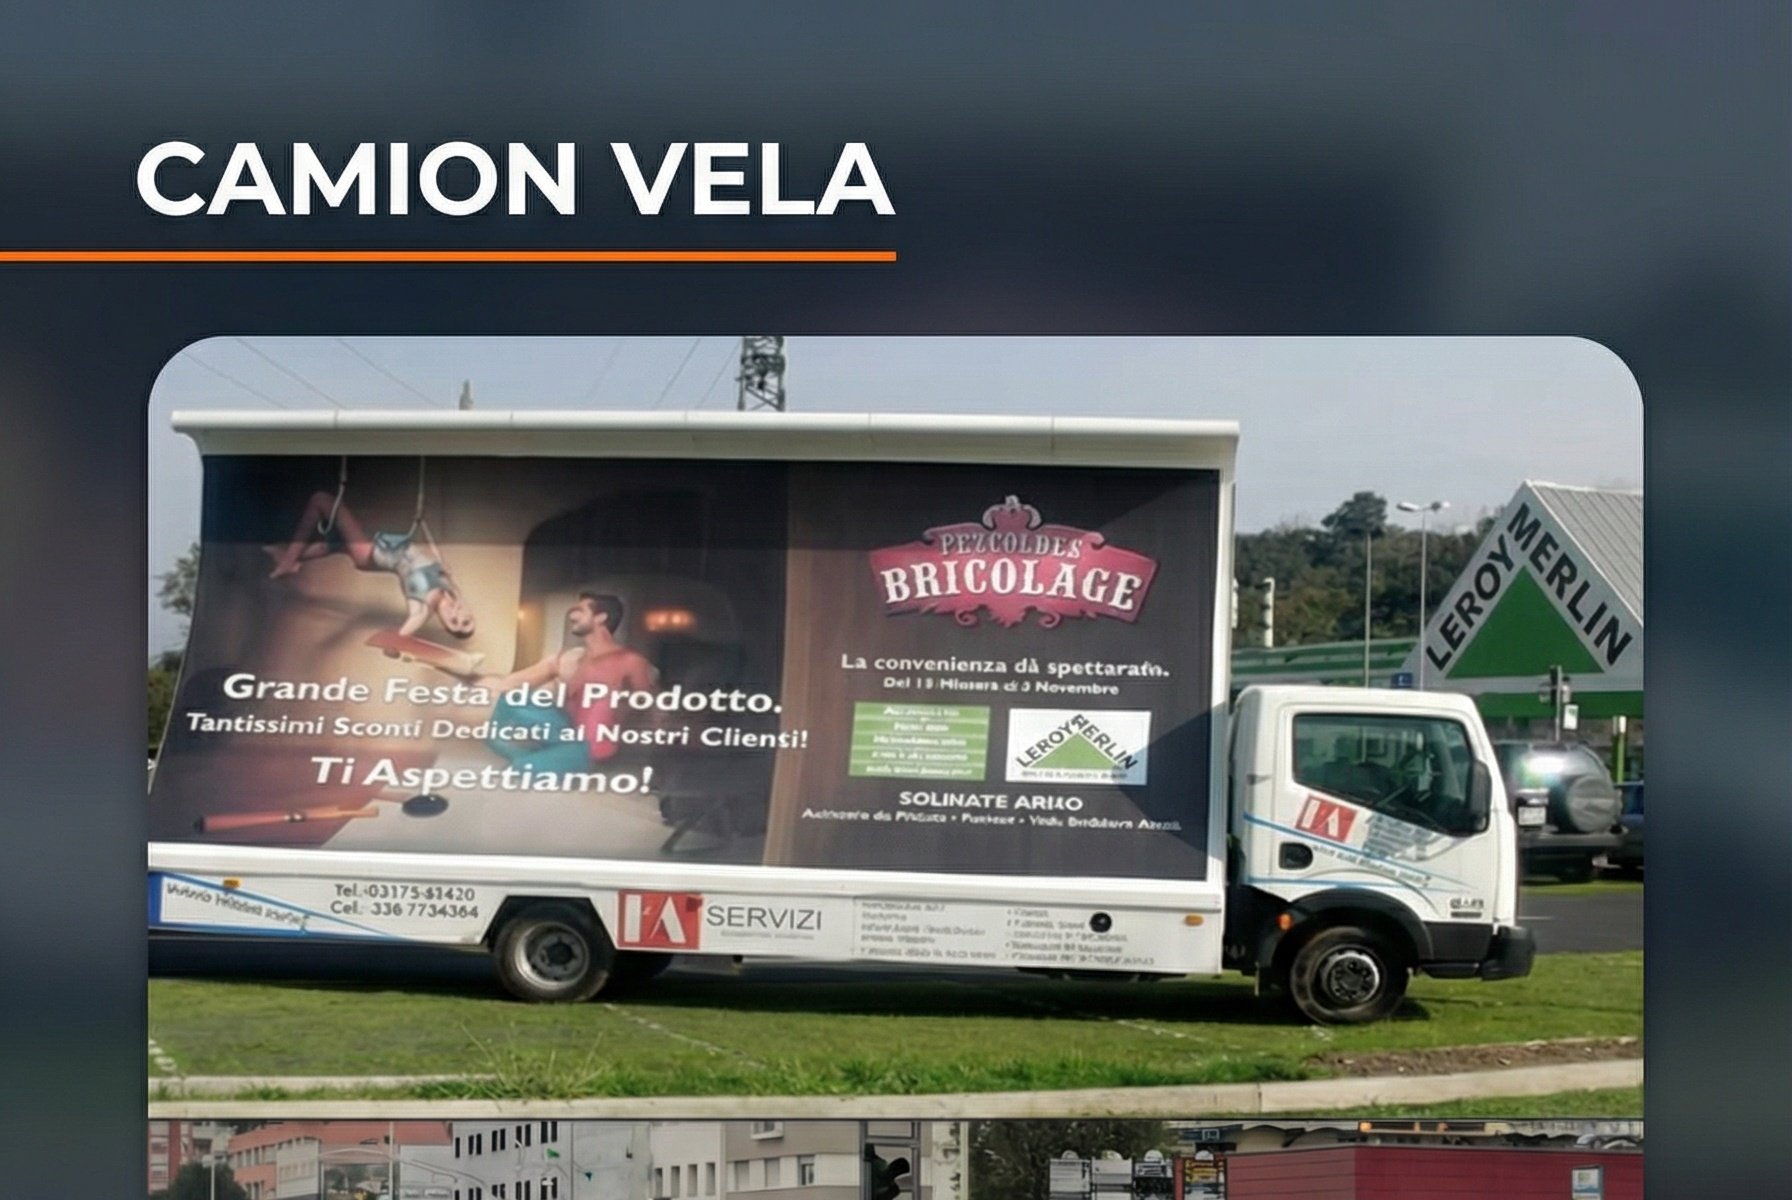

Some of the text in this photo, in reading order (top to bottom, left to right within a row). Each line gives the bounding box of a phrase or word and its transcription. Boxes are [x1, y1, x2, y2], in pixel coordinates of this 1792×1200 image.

[879, 558, 1143, 611] BRICOLAGE
[1426, 502, 1633, 671] LEROY MERLIN
[841, 653, 867, 670] La
[874, 656, 1007, 674] convenienza
[223, 673, 783, 714] Grande Festa del Prodotto.
[1035, 680, 1120, 696] Novembre
[186, 712, 325, 735] Tantissimi
[333, 716, 422, 738] Sconti
[431, 719, 551, 741] Dedicati
[560, 724, 585, 742] ai
[595, 724, 689, 746] Nostri
[1016, 720, 1076, 768] LEROY
[311, 756, 653, 796] Ti Aspettiamo!
[330, 900, 363, 915] Cel.
[706, 904, 822, 931] SERVIZI
